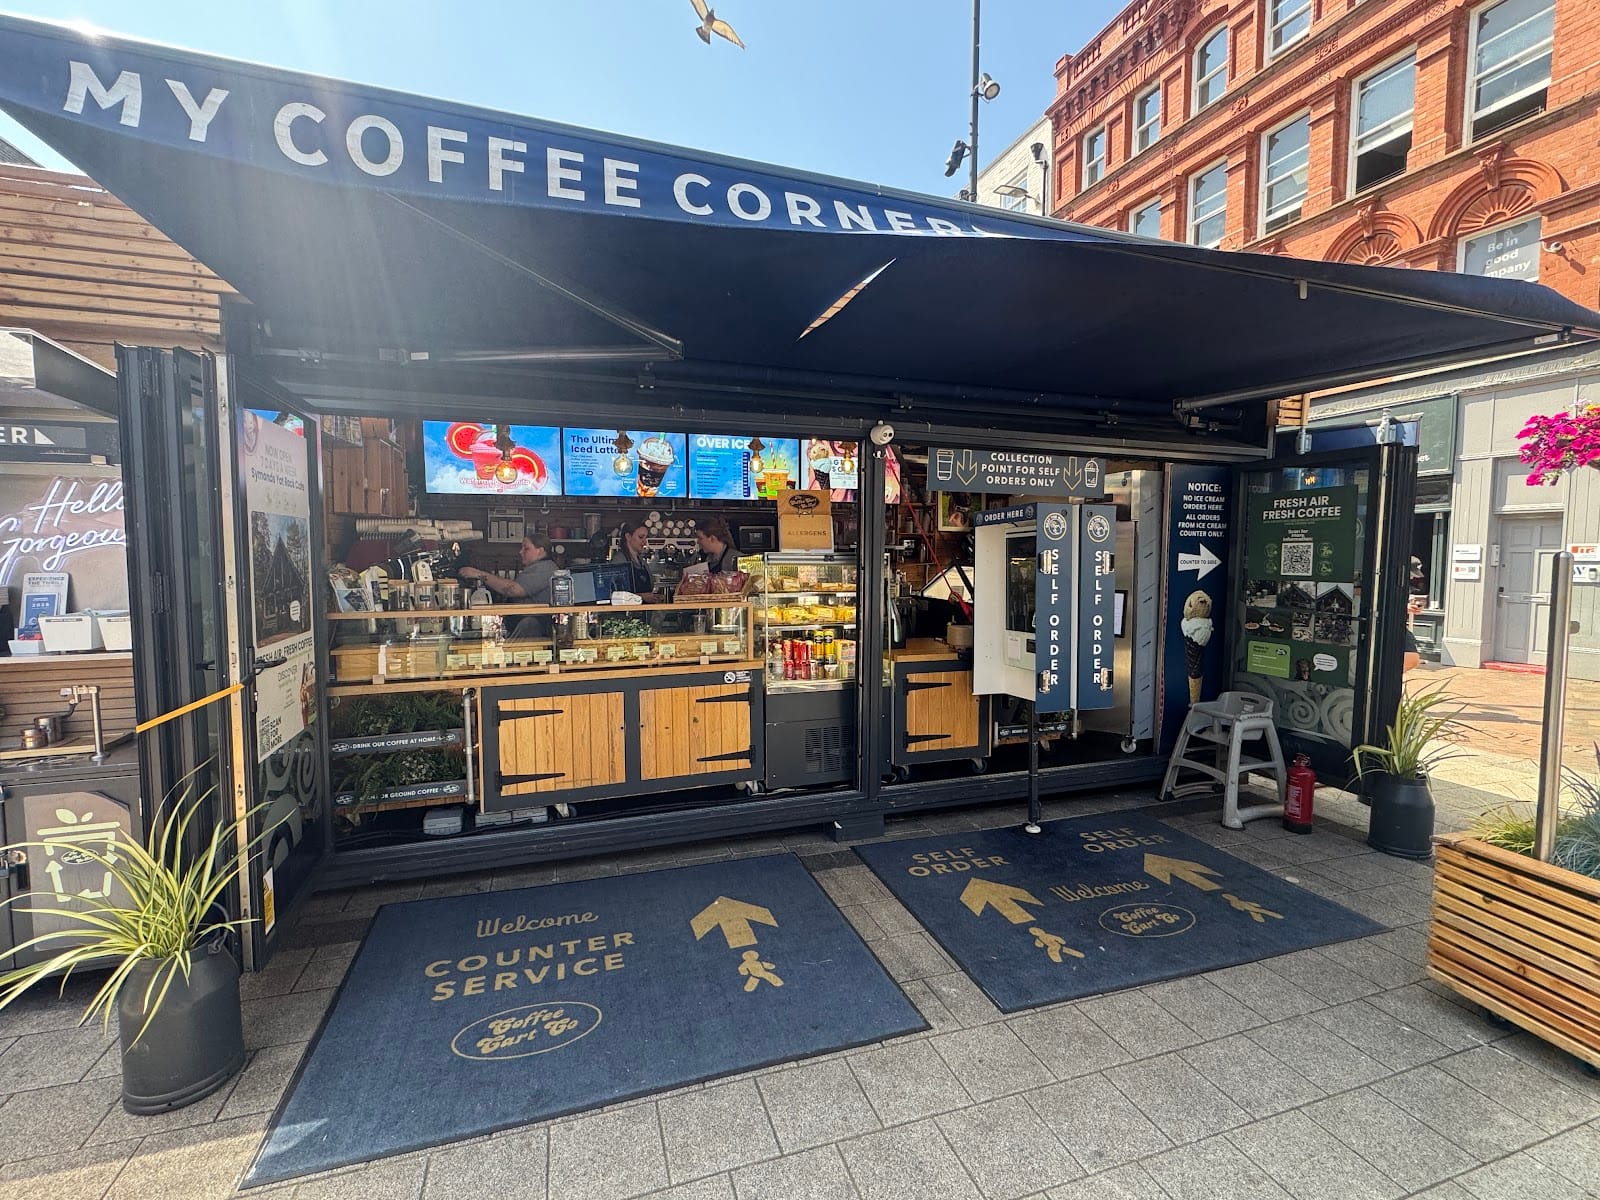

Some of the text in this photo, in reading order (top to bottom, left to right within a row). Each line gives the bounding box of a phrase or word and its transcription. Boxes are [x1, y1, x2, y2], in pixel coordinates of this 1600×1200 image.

[63, 60, 230, 143] MY
[273, 101, 642, 209] COFFEE
[1487, 237, 1518, 253] Be in
[1486, 248, 1519, 269] good
[1486, 260, 1531, 278] mpany
[571, 435, 589, 444] The
[696, 437, 751, 450] OVER ICE
[571, 445, 592, 453] Iced
[990, 452, 1052, 465] COLLECTION
[981, 463, 1061, 477] POINT FOR SELF
[986, 475, 1055, 487] ORDERS ONLY
[1188, 482, 1222, 492] NOTICE:
[1183, 494, 1193, 502] NO
[1273, 496, 1329, 509] FRESH AIR
[1183, 503, 1206, 511] ORDERS
[1263, 506, 1342, 520] FRESH COFFEE
[984, 509, 1024, 522] ORDER HERE
[0, 516, 127, 586] Gorgeou
[1051, 549, 1059, 605] SELF
[1094, 550, 1103, 605] SELF
[284, 643, 298, 657] FRESH
[1049, 614, 1060, 685] ORDER
[1092, 615, 1103, 684] ORDER
[270, 715, 281, 728] SCAN
[352, 742, 371, 750] DRINK
[386, 739, 408, 747] COFFEE
[390, 791, 416, 799] GROUND
[1079, 827, 1136, 842] SELF
[1082, 834, 1173, 854] ORDER
[912, 847, 978, 864] SELF
[908, 855, 1011, 877] ORDER
[1050, 880, 1150, 901] Welcome
[476, 911, 600, 938] Welcome
[424, 932, 635, 978] COUNTER
[431, 952, 625, 1001] SERVICE
